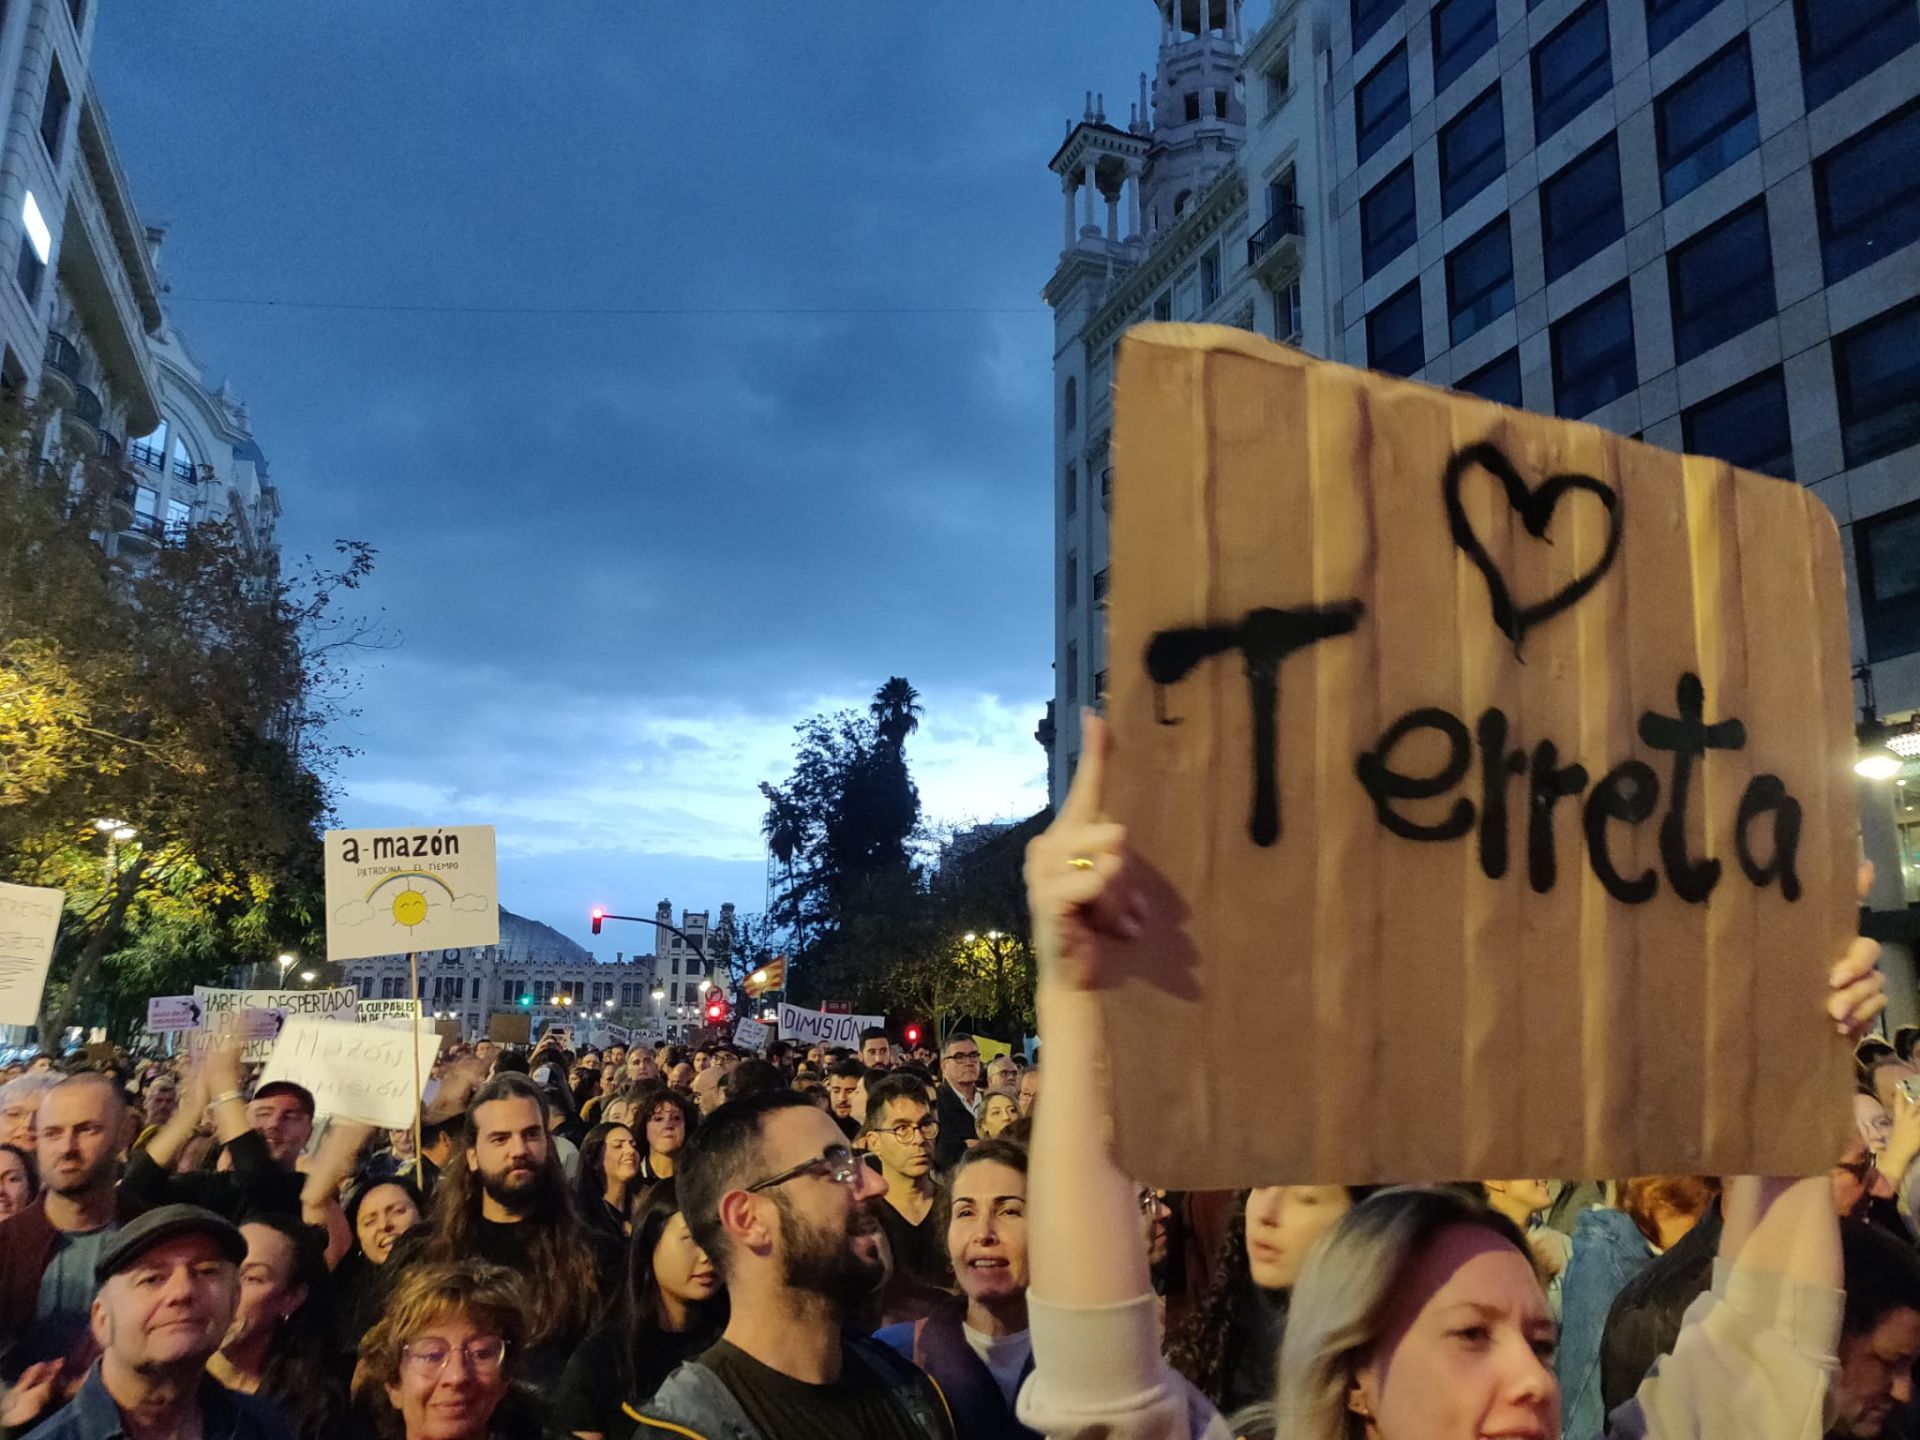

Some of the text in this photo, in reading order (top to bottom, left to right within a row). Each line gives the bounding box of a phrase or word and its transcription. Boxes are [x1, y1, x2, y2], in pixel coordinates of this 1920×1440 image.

[1145, 596, 1803, 904] Terreta
[342, 829, 460, 864] a-mazón
[357, 861, 459, 878] PATROCINA EL TIEMPO
[267, 989, 356, 1015] DESPERTADO
[366, 1001, 415, 1013] CULPABLES
